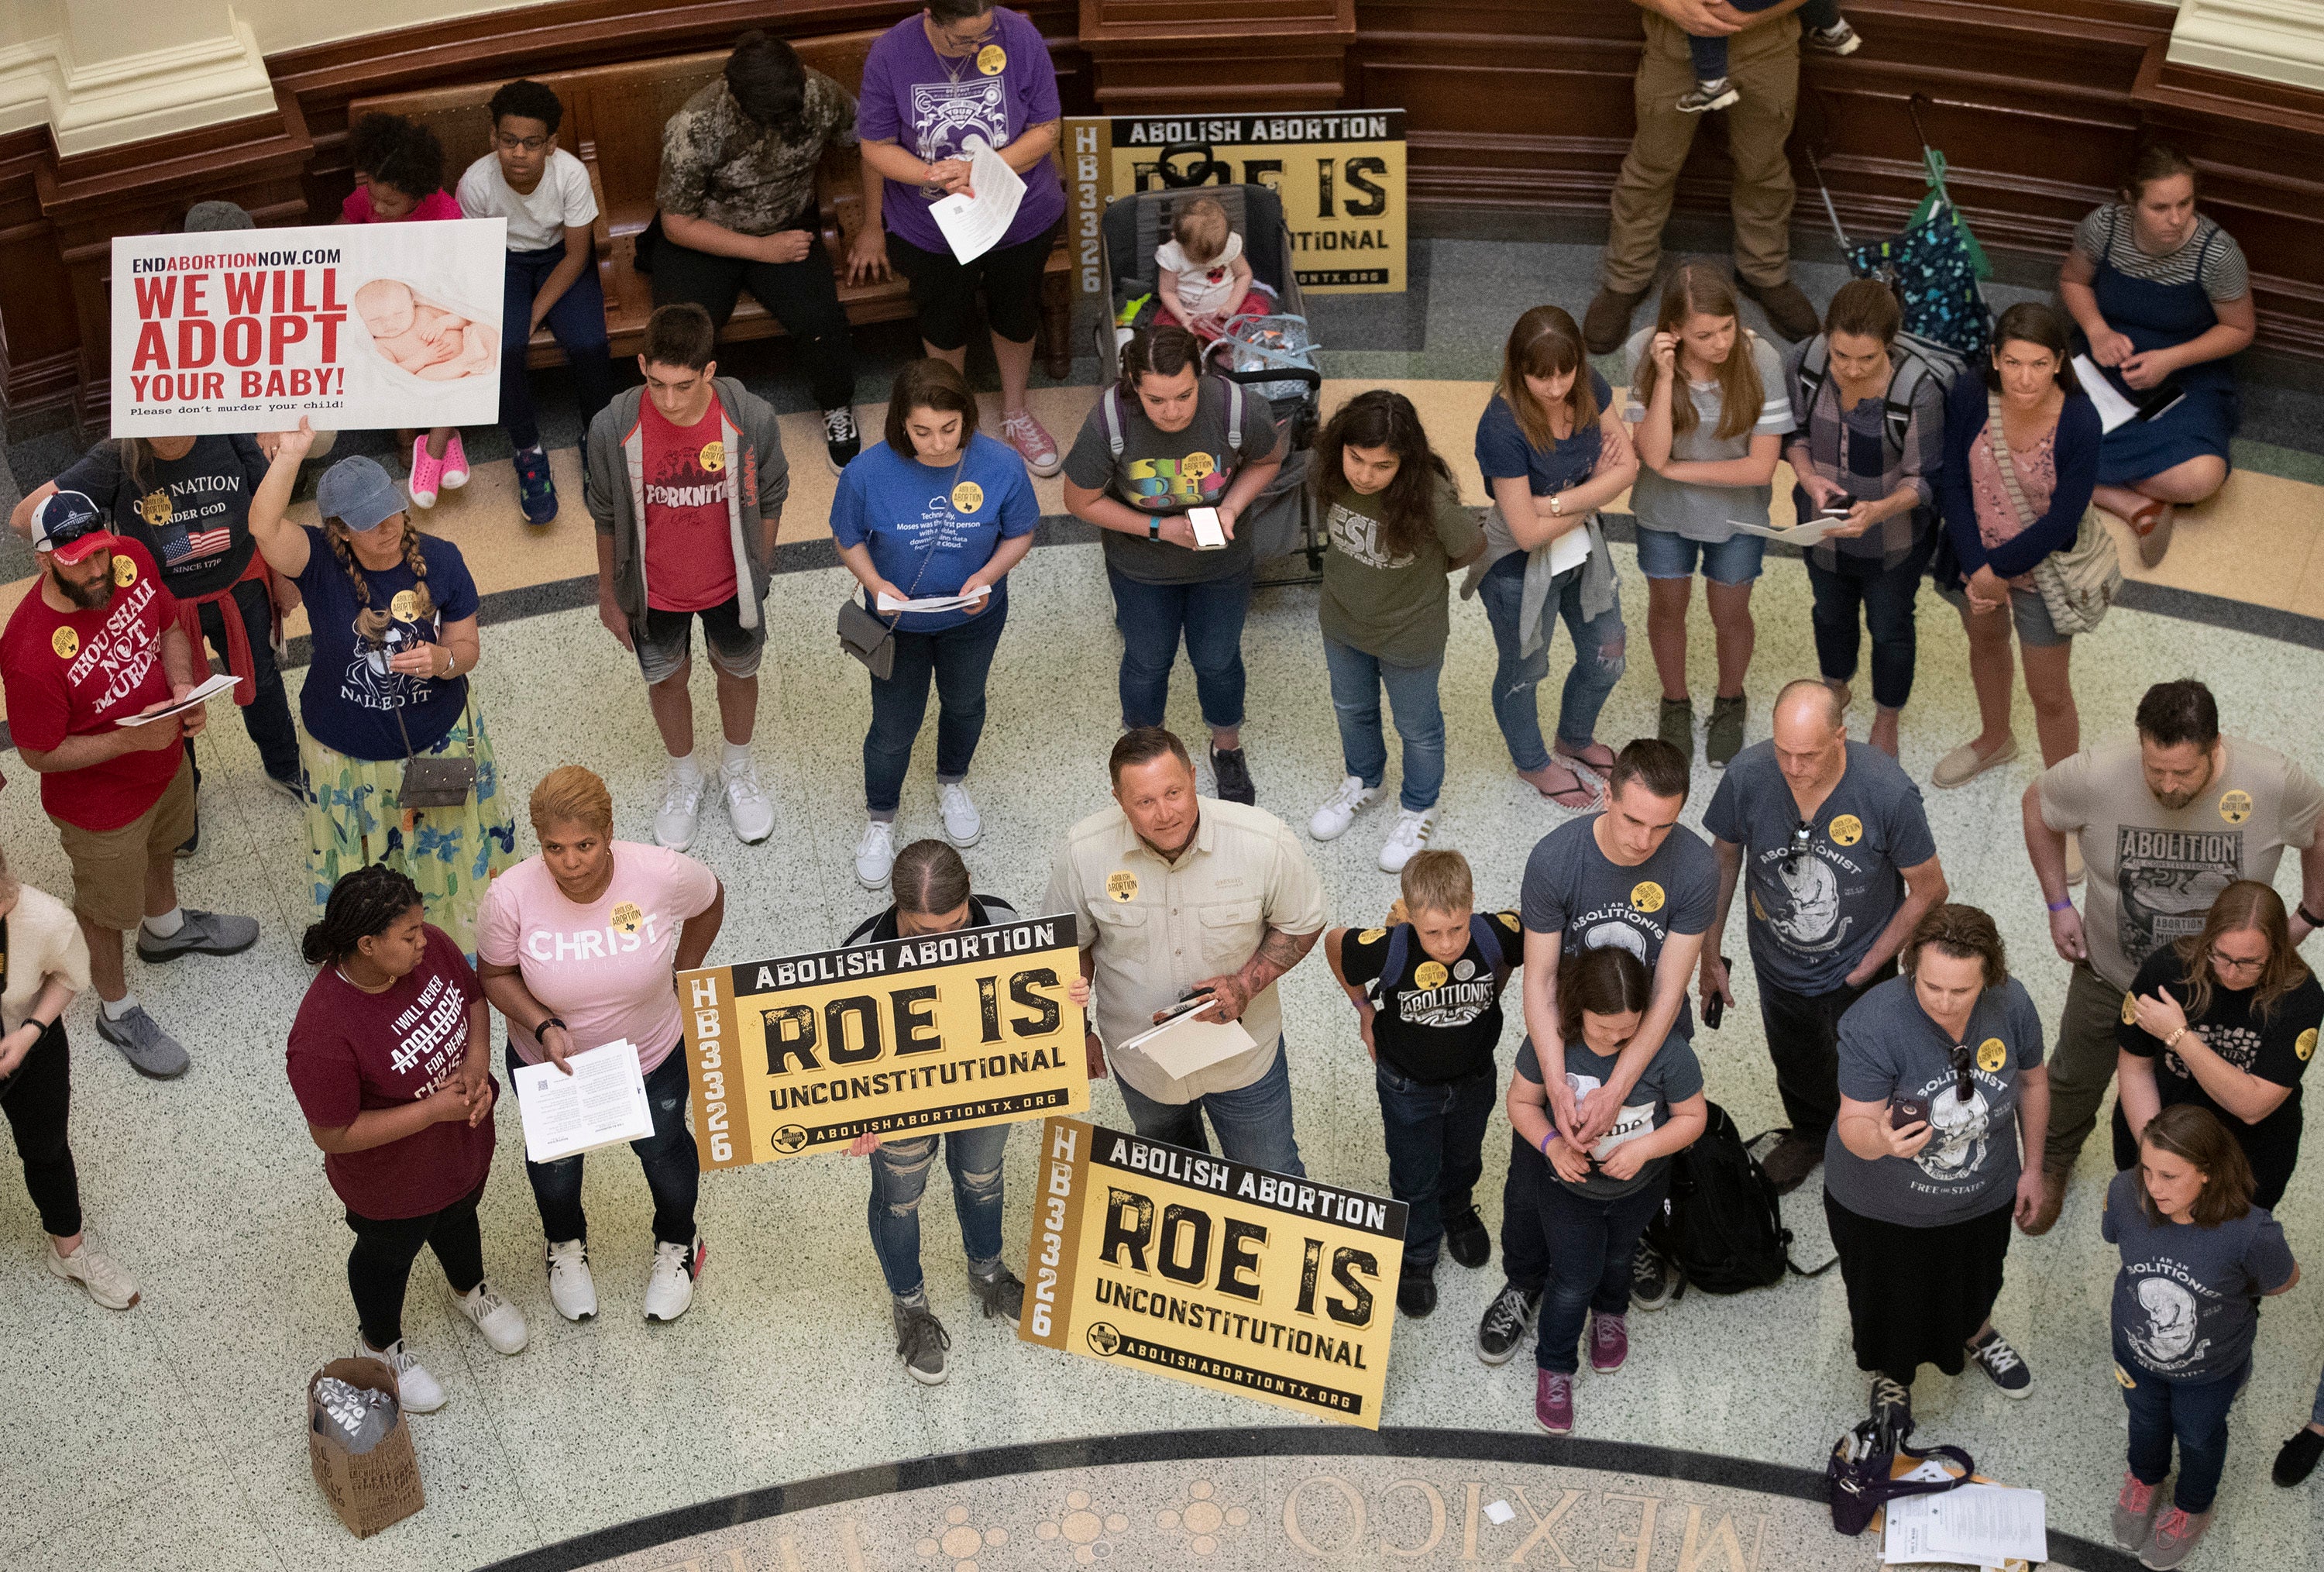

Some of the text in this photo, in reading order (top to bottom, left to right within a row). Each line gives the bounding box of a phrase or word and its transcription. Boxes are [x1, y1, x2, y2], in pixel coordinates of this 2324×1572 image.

[1129, 116, 1387, 143] ABOLISH ABORTION
[1318, 157, 1387, 218] IS
[132, 248, 341, 273] ENDABORTIONNOW.COM
[134, 268, 347, 319] WE WILL
[132, 313, 347, 371] ADOPT
[130, 368, 344, 402] YOUR BABY!
[130, 407, 173, 415] Please
[178, 404, 211, 414] don't
[304, 401, 344, 409] child!
[1184, 461, 1212, 470] ABORTION
[170, 476, 240, 497] NATION
[954, 494, 982, 502] ABORTION
[201, 502, 226, 515] GOD
[173, 562, 202, 573] SINCE
[67, 628, 109, 687] THOU
[340, 685, 431, 710] NAILED IT
[1831, 824, 1860, 837] ABORTION
[2123, 831, 2236, 862] ABOLITION
[1108, 880, 1137, 893] ABORTION
[1112, 873, 1130, 882] ABOLISH
[614, 903, 634, 915] ABOLISH
[1636, 885, 1659, 910] ABORTION
[612, 910, 642, 927] ABORTION
[1572, 909, 1665, 944] ABOLITIONIS
[2156, 919, 2203, 928] ABORTION
[528, 913, 658, 961] CHRIST
[755, 923, 1056, 989] ABOLISH ABORTION
[1418, 971, 1446, 982] ABORTION
[390, 975, 444, 1036] I WILL NEVER
[759, 968, 1063, 1076] ROE IS
[425, 1053, 446, 1076] FOR
[770, 1047, 1067, 1111] UNCONSTITUTIONAL
[1109, 1138, 1387, 1230] ABOLISH ABORTION
[1910, 1181, 1939, 1194] FREE
[1099, 1185, 1380, 1328] ROE IS
[1095, 1278, 1367, 1370] UNCONSTITUTIONAL
[1127, 1343, 1351, 1409] ABOLISHABORTIONTX.ORG
